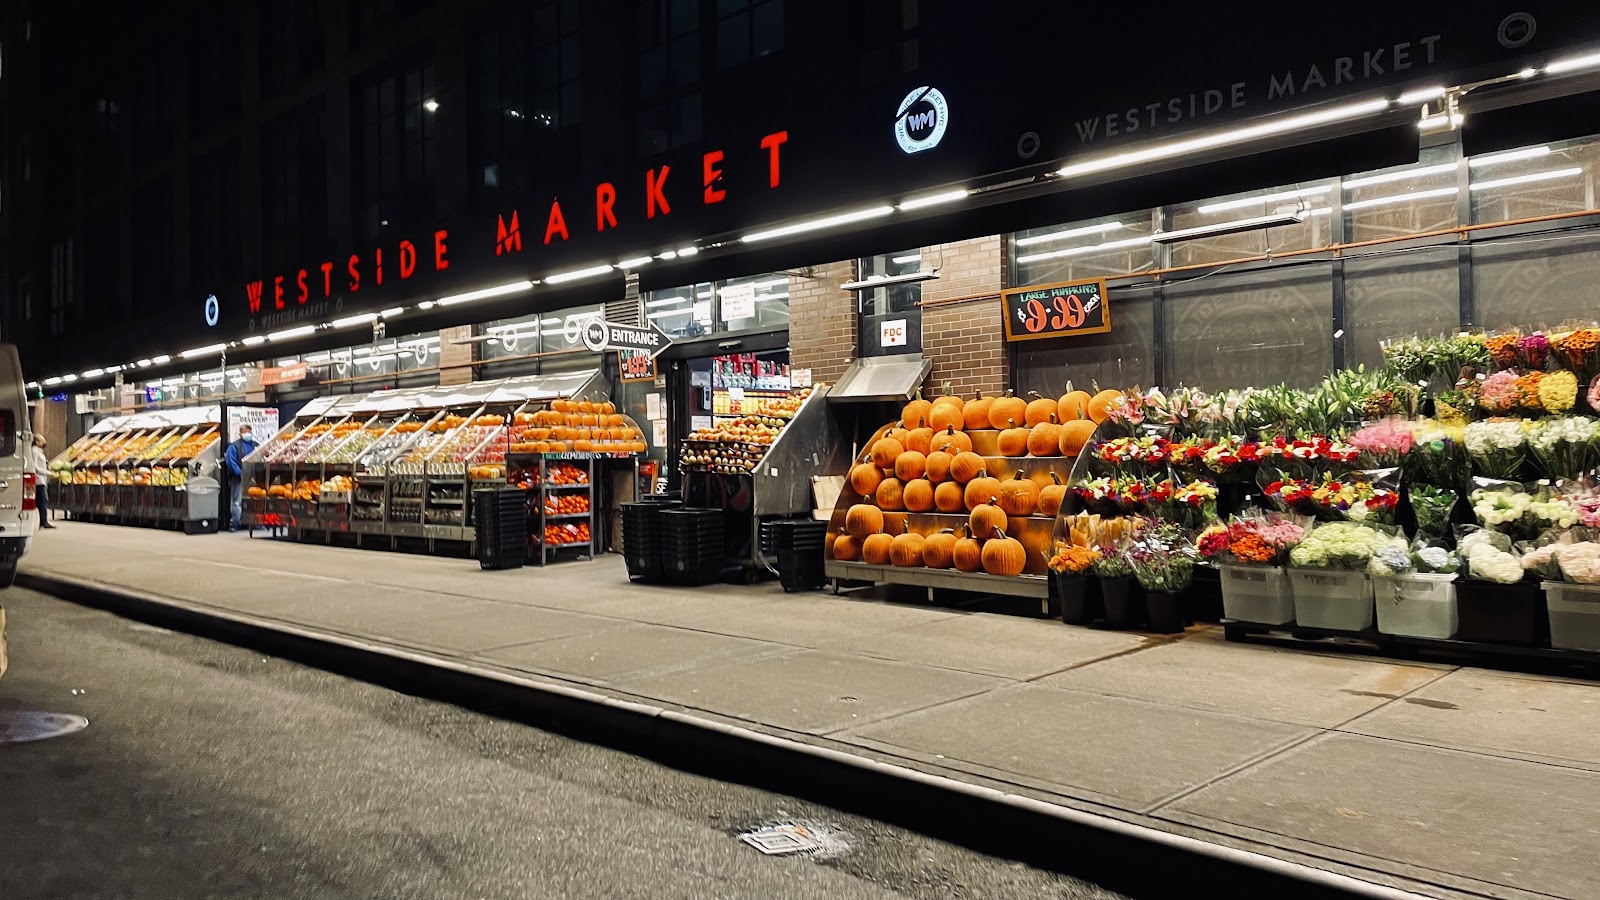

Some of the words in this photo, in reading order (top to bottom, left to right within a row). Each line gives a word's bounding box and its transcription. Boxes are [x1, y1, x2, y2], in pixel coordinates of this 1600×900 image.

[1074, 81, 1247, 144] WESTSIDE
[1267, 34, 1442, 101] MARKET
[908, 109, 935, 132] WM
[246, 230, 449, 313] WESTSIDE
[495, 130, 789, 255] MARKET
[298, 300, 329, 318] MARKET
[588, 328, 603, 340] WM
[611, 328, 659, 346] ENTRANCE
[883, 327, 902, 338] FDC
